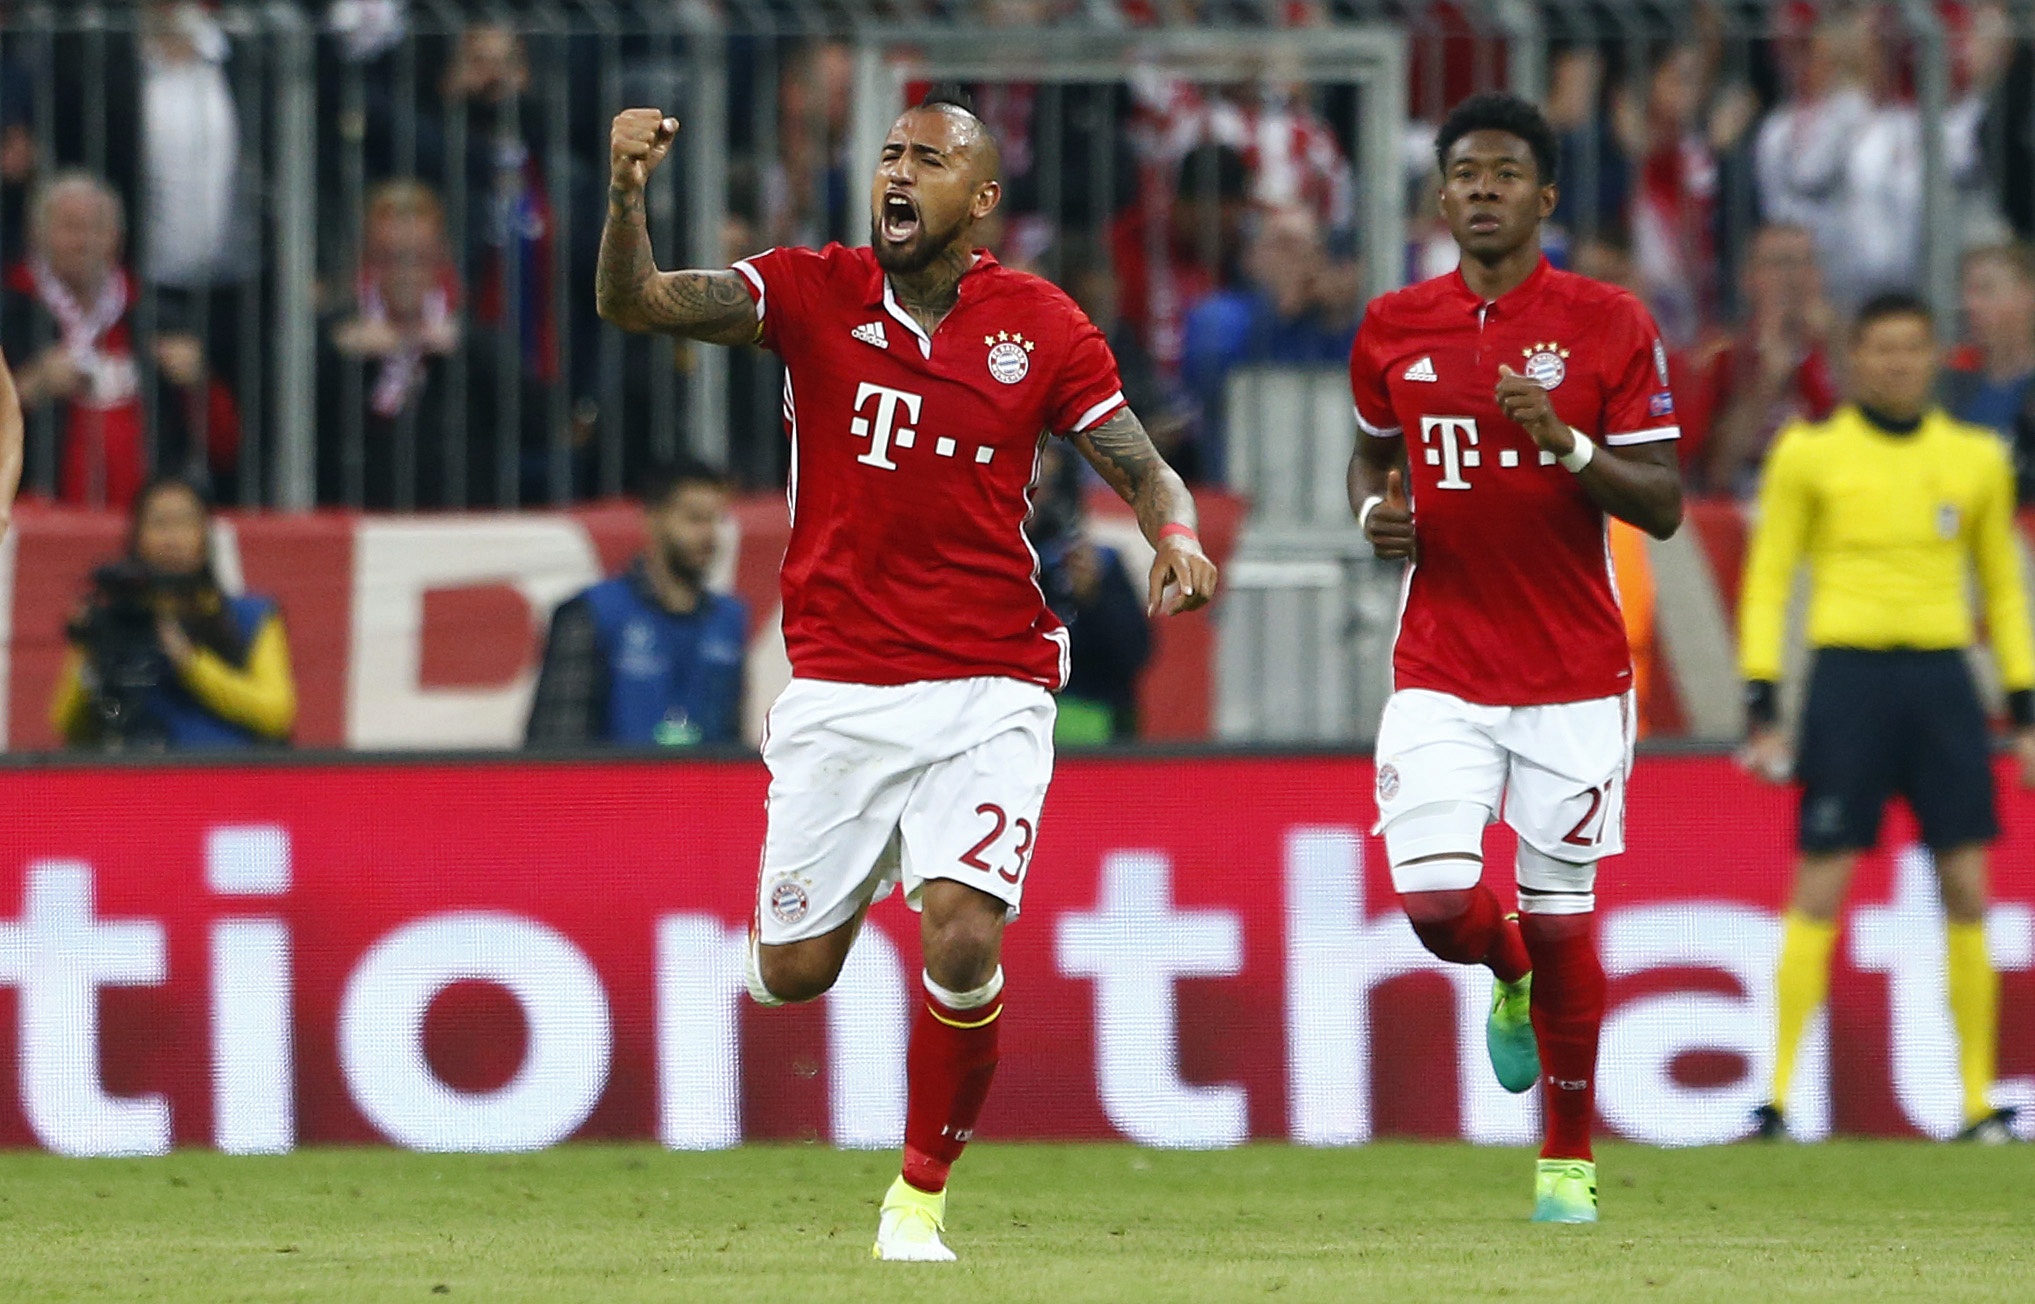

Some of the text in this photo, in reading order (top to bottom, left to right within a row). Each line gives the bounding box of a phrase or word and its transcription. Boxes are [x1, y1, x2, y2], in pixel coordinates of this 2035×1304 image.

[958, 802, 1033, 884] 23
[0, 825, 2035, 1155] tion that
